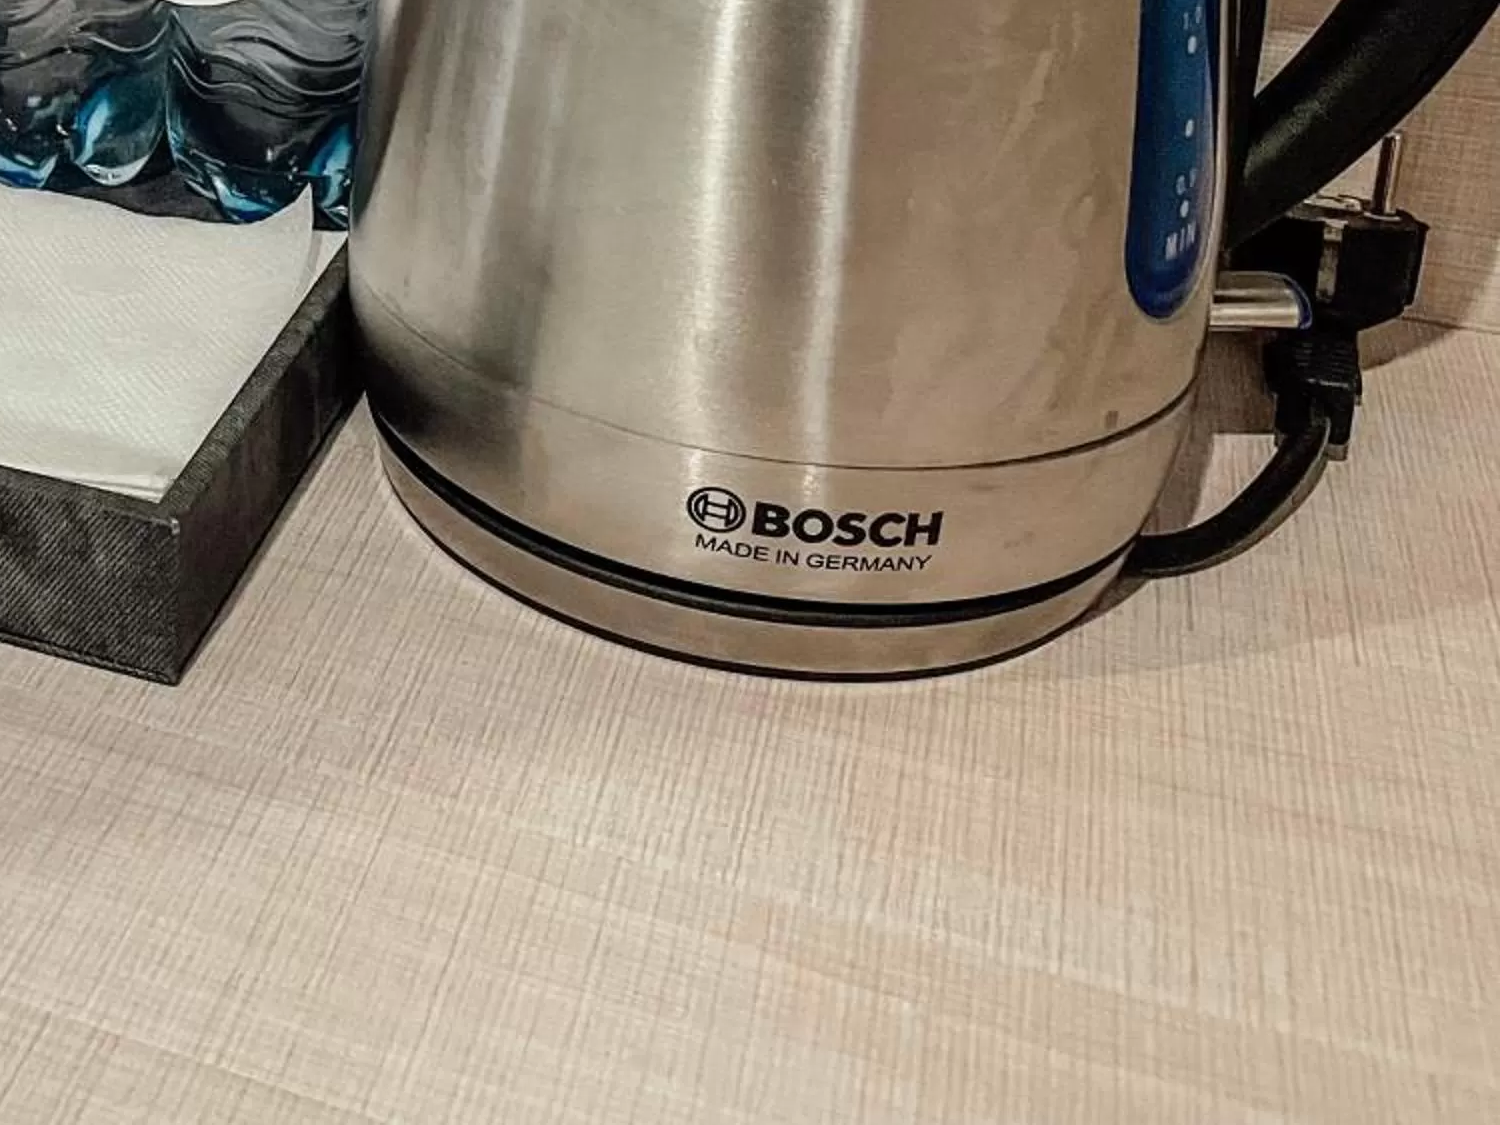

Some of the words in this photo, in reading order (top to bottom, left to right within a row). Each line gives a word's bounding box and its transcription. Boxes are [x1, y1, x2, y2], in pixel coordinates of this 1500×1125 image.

[751, 501, 945, 548] BOSCH
[695, 534, 768, 562] MADE
[776, 550, 799, 566] IN
[806, 554, 932, 572] GERMANY
